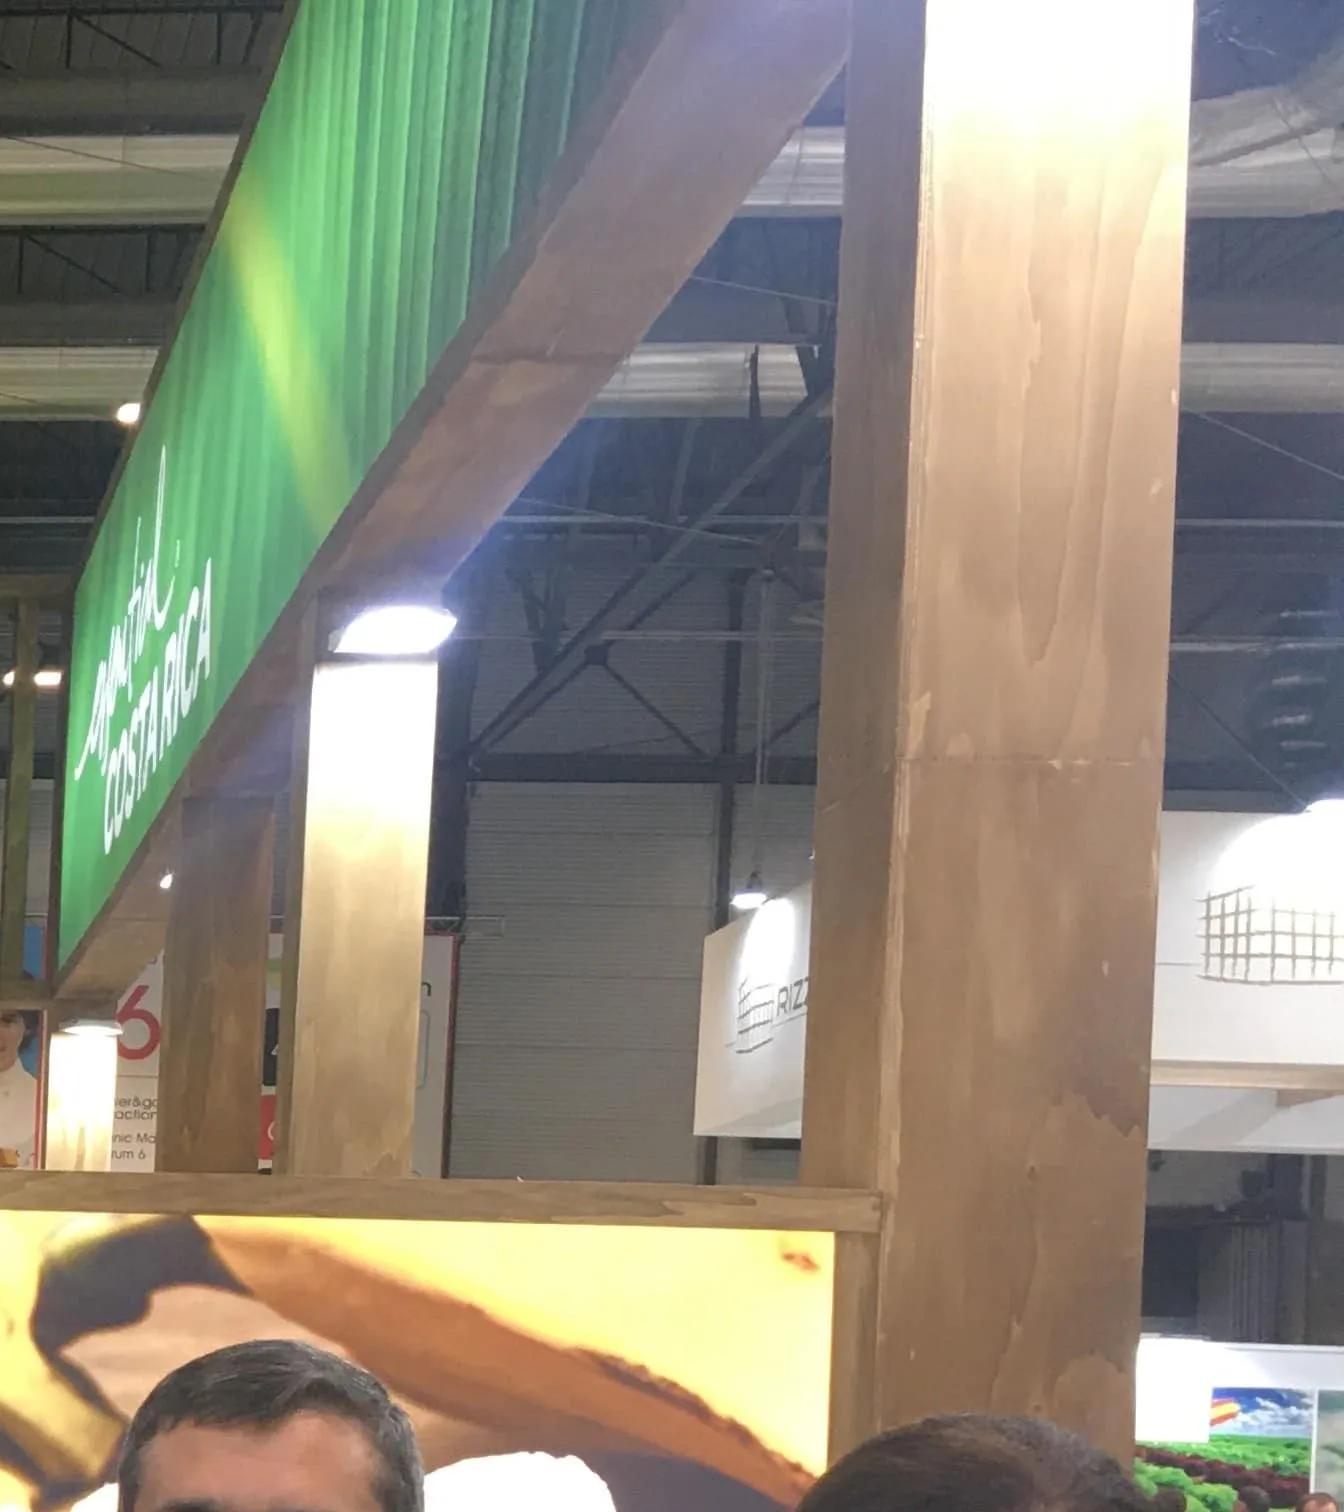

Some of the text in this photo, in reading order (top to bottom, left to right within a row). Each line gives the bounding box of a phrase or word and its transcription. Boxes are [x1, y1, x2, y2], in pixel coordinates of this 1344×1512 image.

[104, 557, 212, 855] COSTA RICA
[116, 985, 161, 1061] 6
